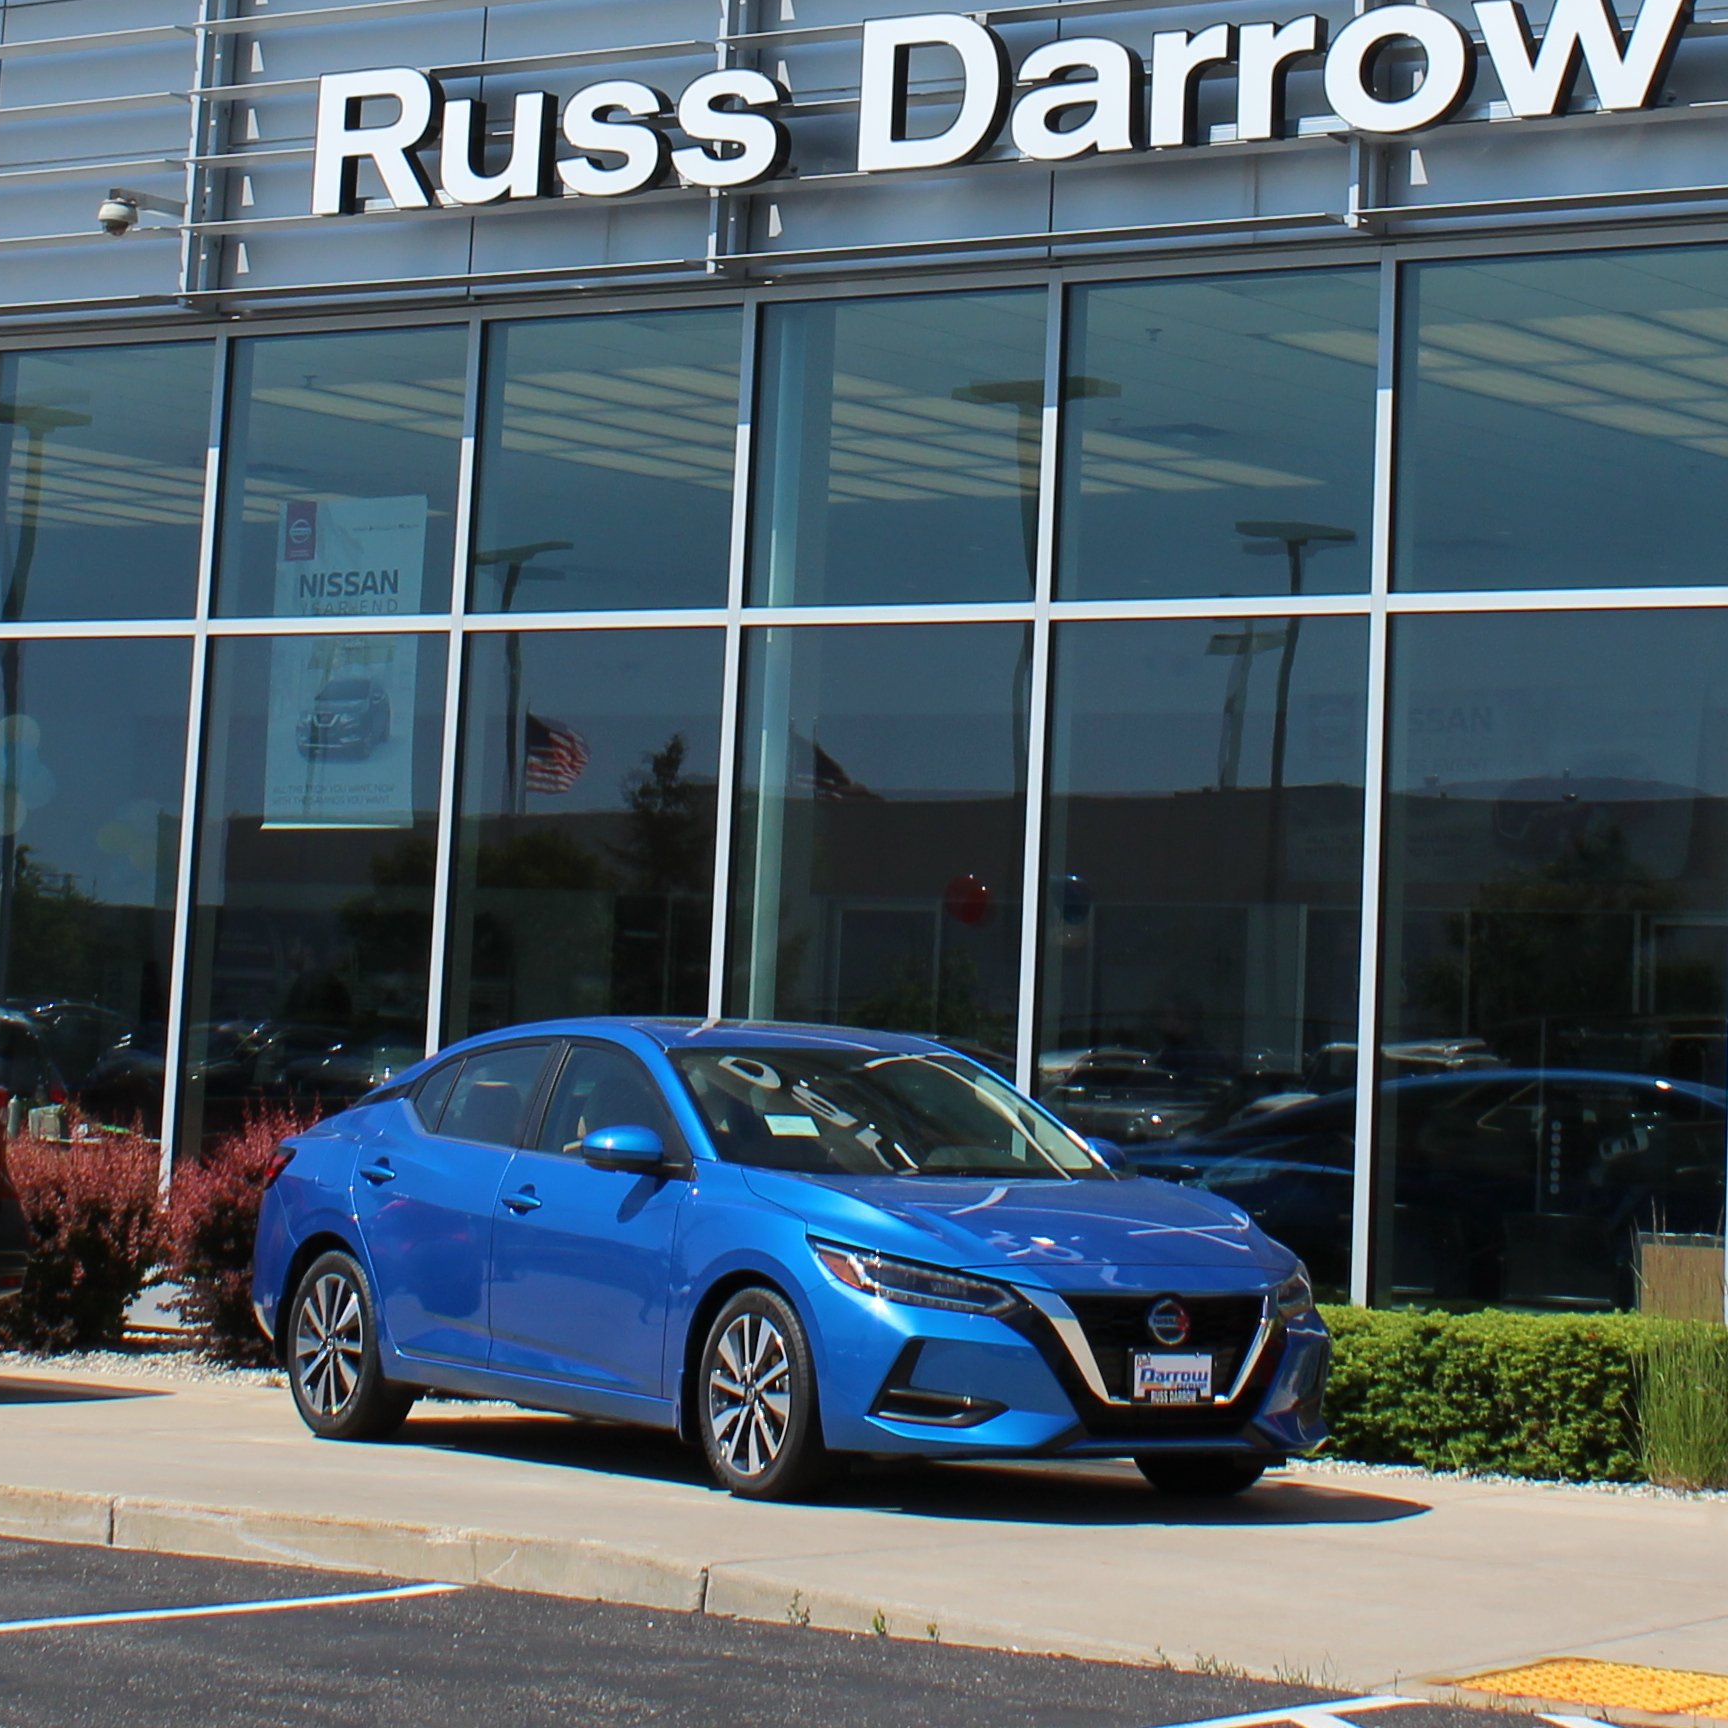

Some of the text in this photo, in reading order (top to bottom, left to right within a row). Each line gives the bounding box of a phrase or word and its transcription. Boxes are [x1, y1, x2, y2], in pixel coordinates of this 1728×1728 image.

[310, 66, 791, 215] Russ
[299, 569, 399, 598] NISSAN
[1140, 1368, 1208, 1383] Darrow
